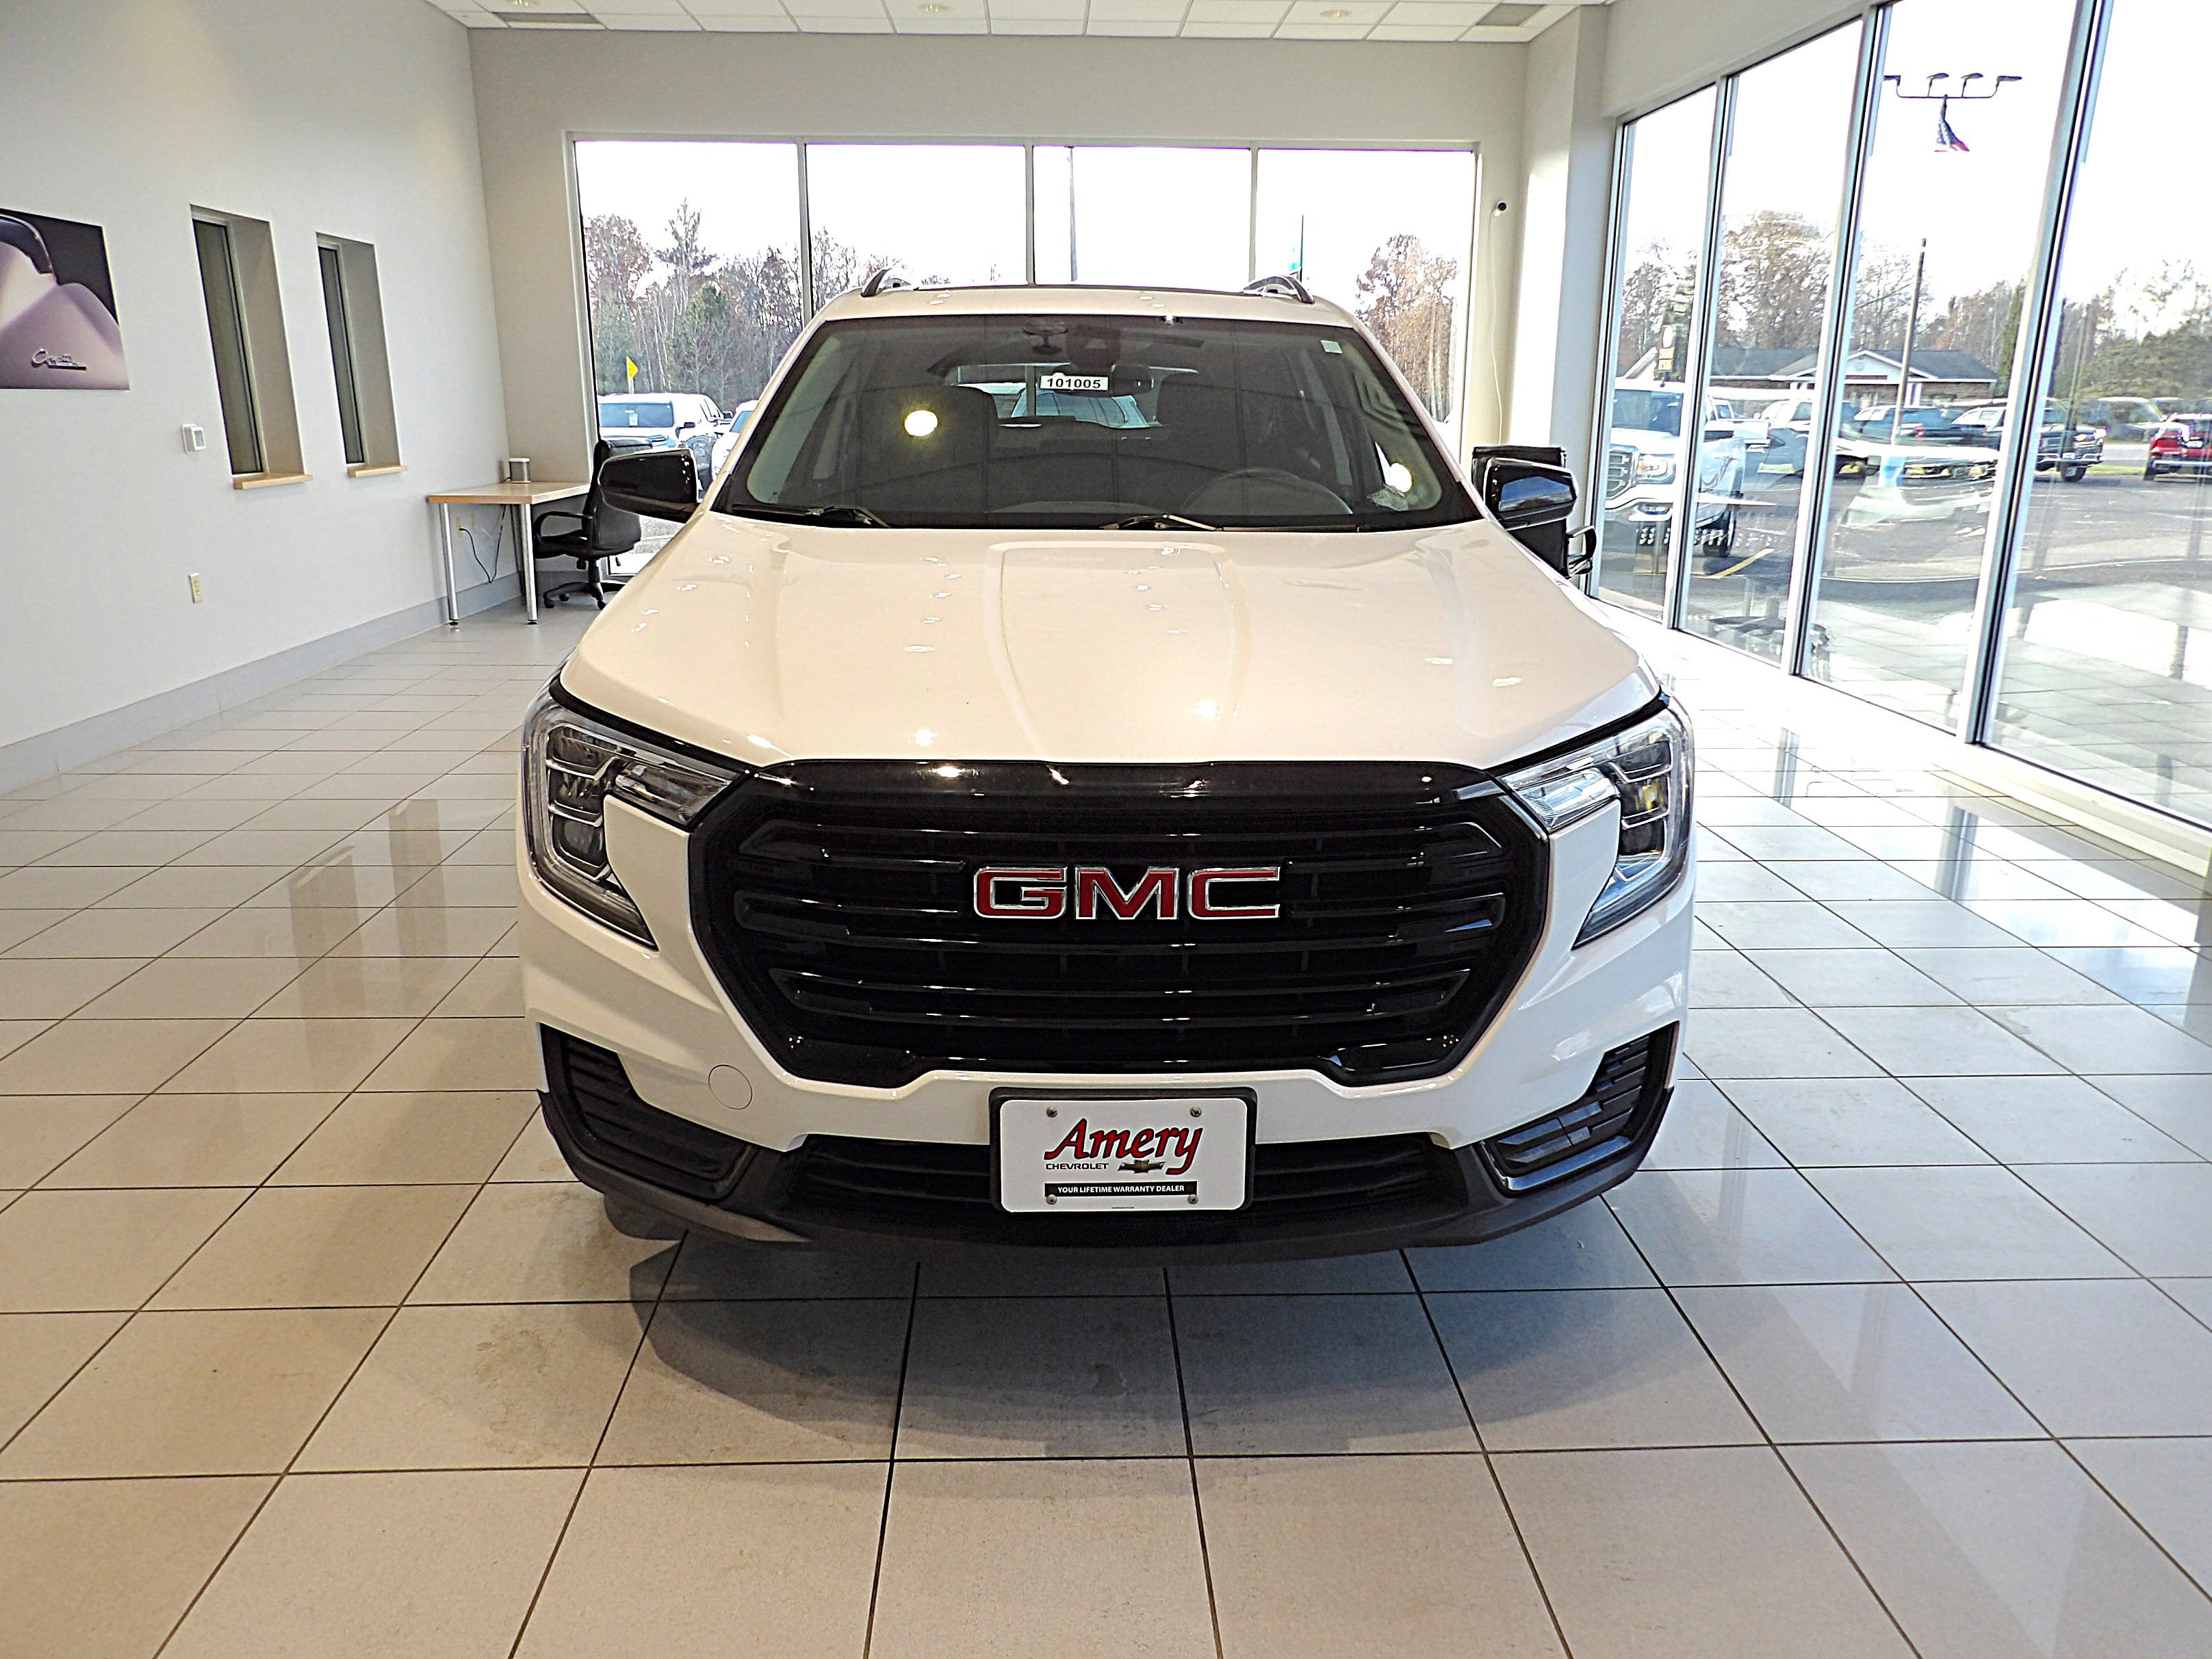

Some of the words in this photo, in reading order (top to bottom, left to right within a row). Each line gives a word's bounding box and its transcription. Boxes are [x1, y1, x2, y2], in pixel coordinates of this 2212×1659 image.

[1046, 378, 1101, 389] 101005
[973, 866, 1280, 920] GMC
[1044, 1118, 1203, 1175] Amery
[1046, 1162, 1109, 1170] CHEVROLET
